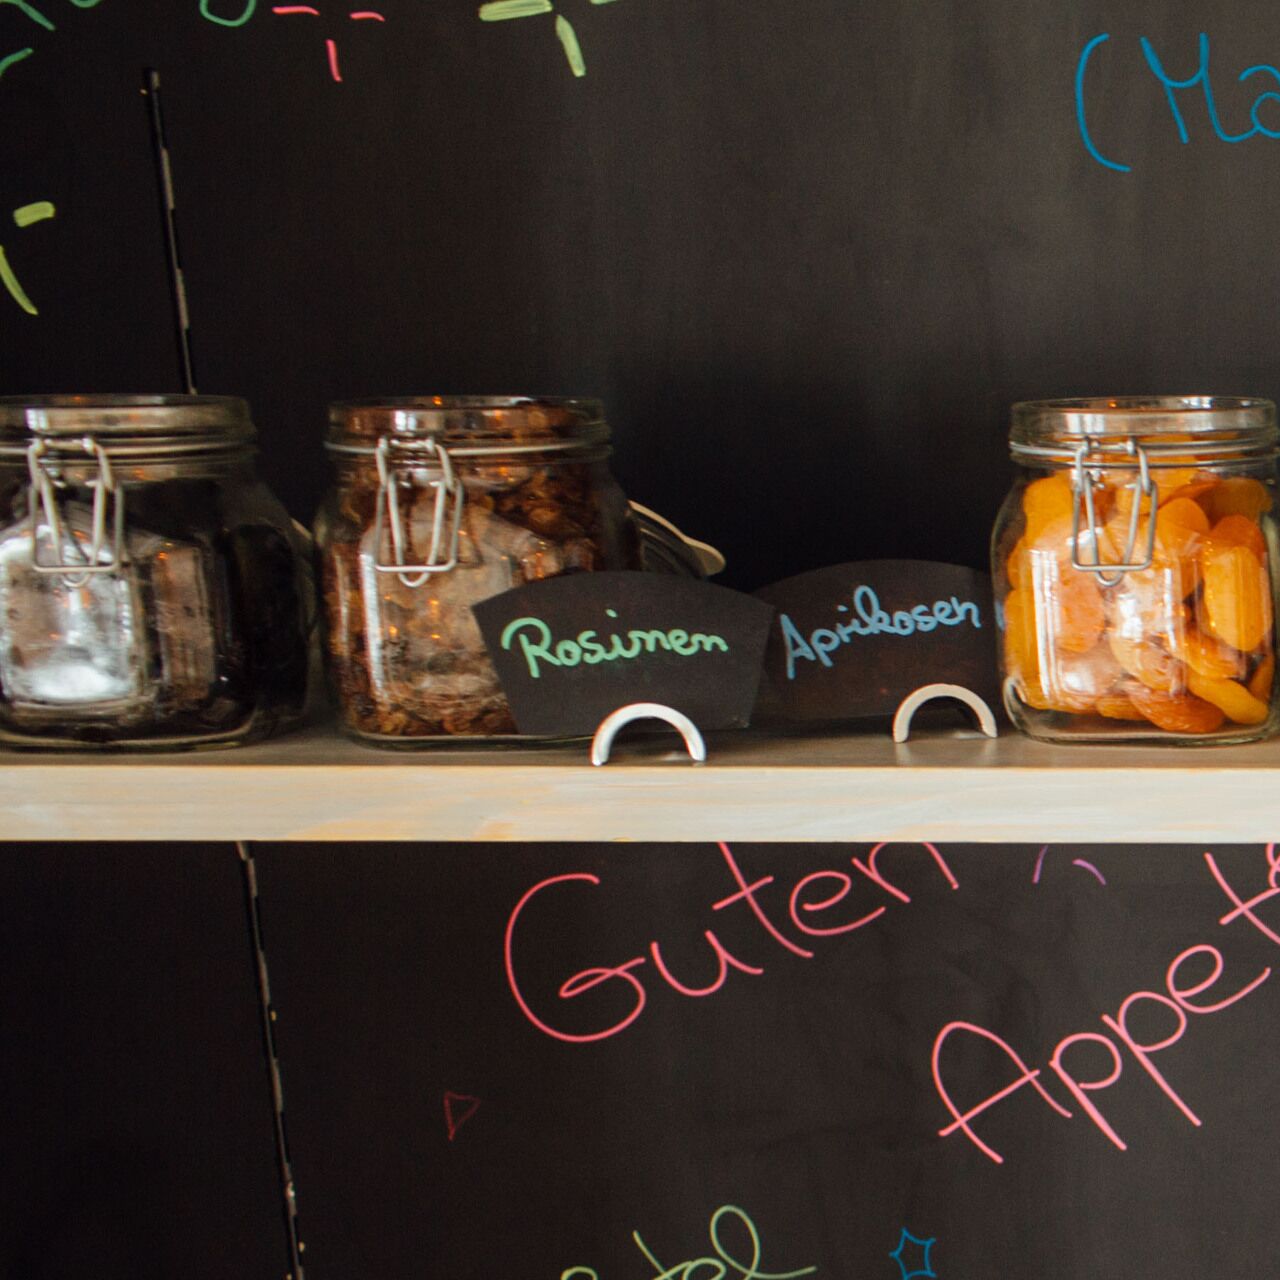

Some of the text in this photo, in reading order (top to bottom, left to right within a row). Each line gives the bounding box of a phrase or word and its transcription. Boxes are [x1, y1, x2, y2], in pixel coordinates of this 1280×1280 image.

[501, 608, 729, 679] Rosinen
[780, 585, 982, 681] Aprikosen
[504, 843, 958, 1043] Guten
